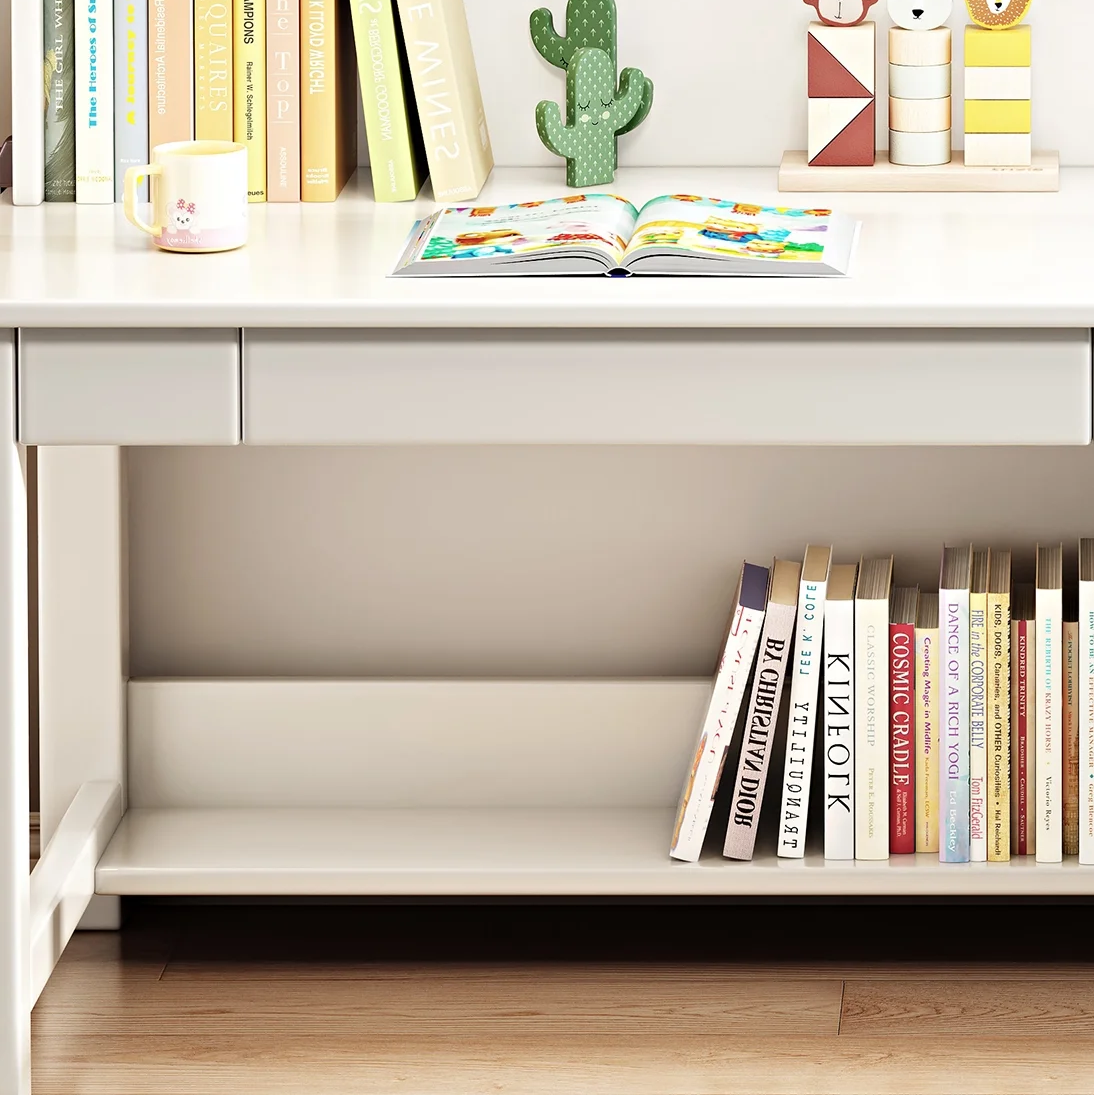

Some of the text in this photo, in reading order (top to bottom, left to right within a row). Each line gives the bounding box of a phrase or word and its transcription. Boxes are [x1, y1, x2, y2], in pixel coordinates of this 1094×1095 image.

[55, 35, 64, 74] GIRL
[88, 17, 96, 33] of
[55, 79, 64, 113] THE
[89, 97, 97, 128] The
[893, 633, 909, 785] COSMIC CRADLE
[948, 604, 959, 779] DANCE OF A RICH YOGI
[971, 610, 985, 749] FIRE in the CORPORATE BELLY
[994, 663, 1002, 700] Canaries,
[867, 685, 875, 746] WORSHIP
[948, 791, 957, 852] Ed Beckley
[971, 777, 984, 839] Tom FitzGerald
